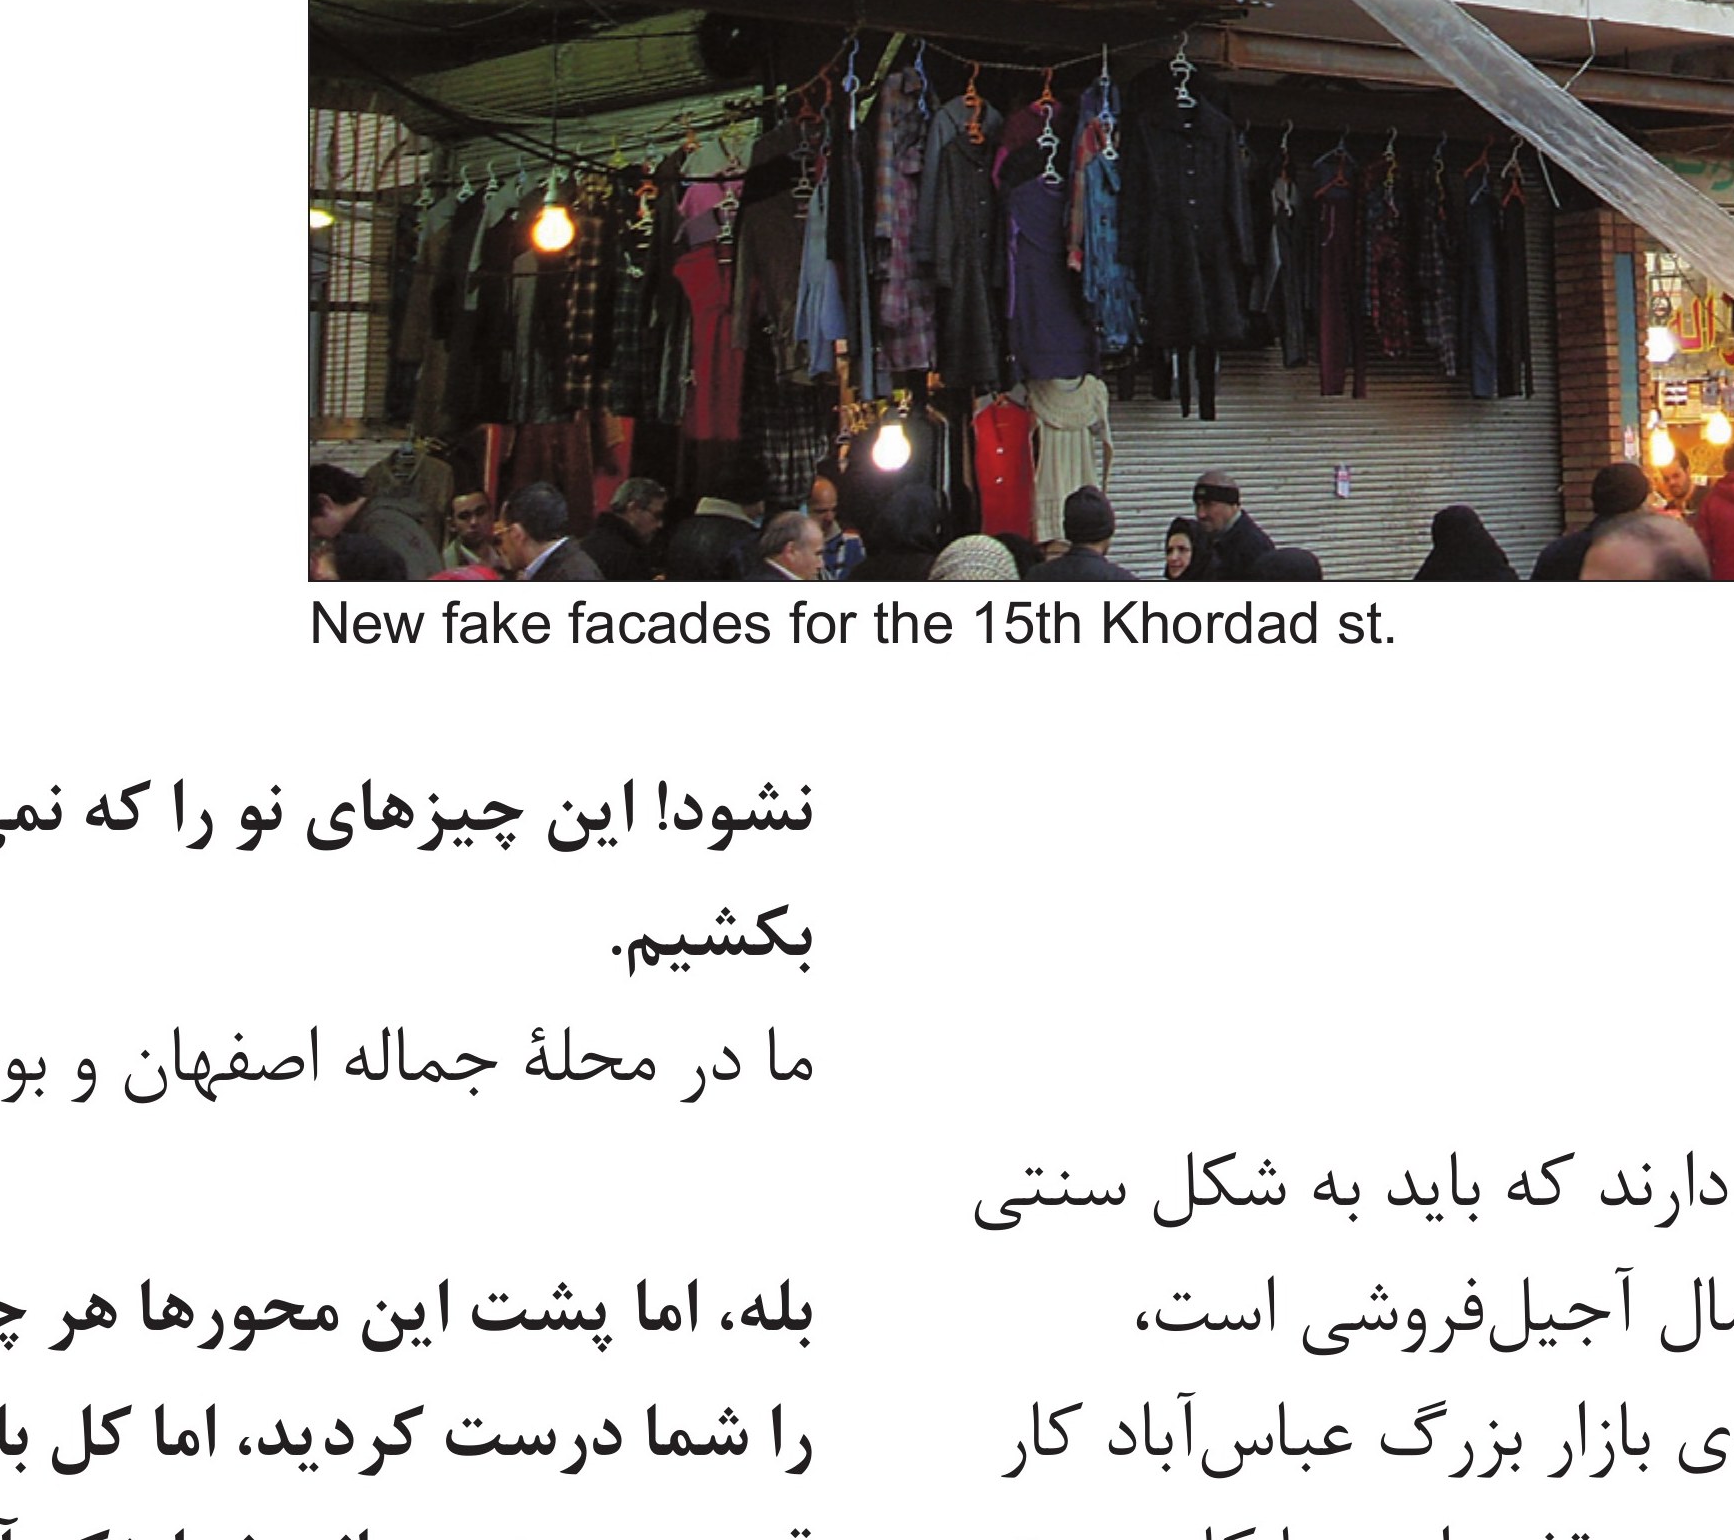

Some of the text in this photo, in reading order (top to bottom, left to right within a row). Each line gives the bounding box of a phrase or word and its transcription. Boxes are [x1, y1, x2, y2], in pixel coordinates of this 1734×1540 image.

[313, 600, 1393, 644] New fake facades for the 15th Khordad st.
[86, 780, 151, 830] که
[174, 779, 213, 849] را
[236, 785, 282, 851] نو
[307, 779, 523, 851] چیزهای
[548, 779, 633, 852] این
[659, 780, 812, 851] نشود!
[612, 904, 812, 977] بکشیم.
[71, 1059, 96, 1102] و
[125, 1026, 317, 1103] اصفهان
[346, 1027, 497, 1096] جماله
[680, 1046, 740, 1103] در
[769, 1027, 812, 1080] ما
[975, 1167, 1125, 1230] سنتی
[1154, 1152, 1285, 1227] شکل
[1314, 1171, 1360, 1222] به
[1388, 1152, 1480, 1222] باید
[1508, 1152, 1575, 1205] که
[1601, 1151, 1727, 1228] دارند
[48, 1294, 117, 1351] هر
[141, 1279, 338, 1351] محورها
[362, 1279, 448, 1352] این
[472, 1282, 612, 1352] پشت
[637, 1279, 697, 1332] اما
[721, 1279, 812, 1348] بله،
[1137, 1276, 1274, 1331] است،
[52, 1404, 132, 1475] کل
[155, 1404, 215, 1457] اما
[239, 1405, 424, 1476] کردید،
[446, 1418, 622, 1474] درست
[647, 1404, 748, 1456] شما
[772, 1404, 812, 1474] را
[1001, 1402, 1083, 1478] کار
[1381, 1400, 1522, 1478] بزرگ
[1547, 1401, 1650, 1478] بازار
